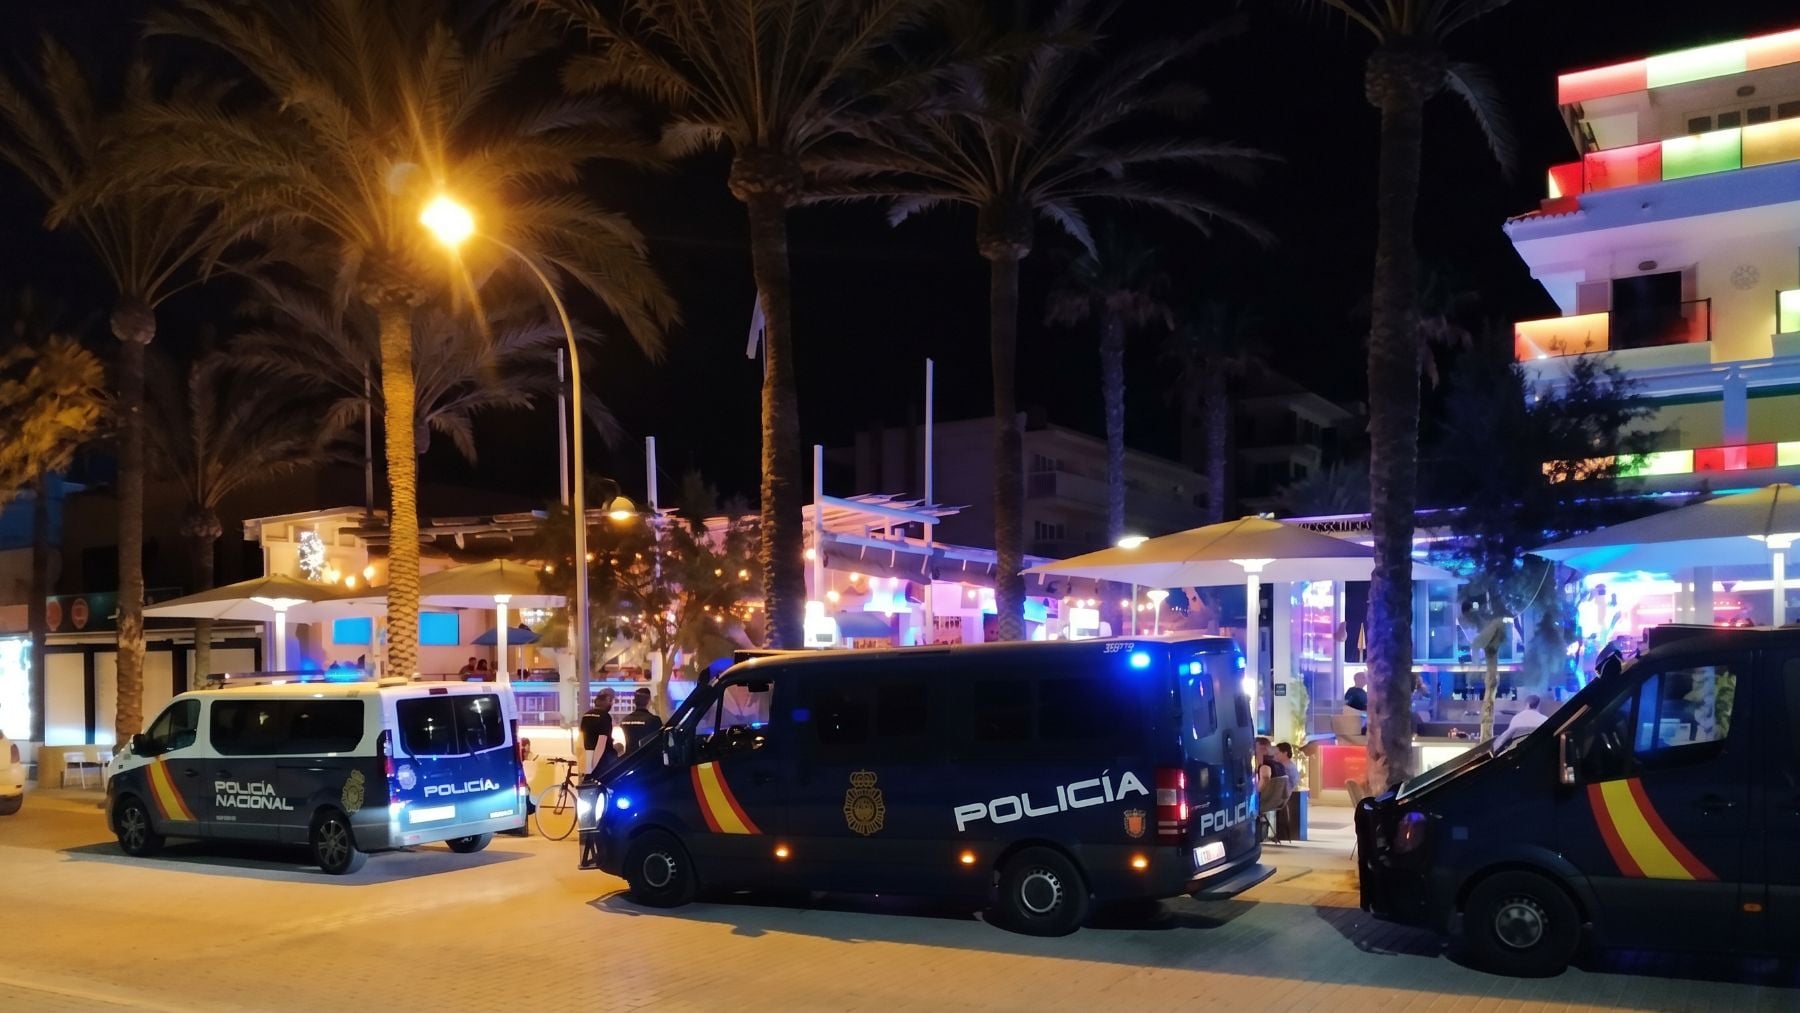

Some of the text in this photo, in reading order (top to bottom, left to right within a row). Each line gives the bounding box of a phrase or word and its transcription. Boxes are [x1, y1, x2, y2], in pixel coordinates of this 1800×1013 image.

[214, 780, 276, 796] POLICÍA
[423, 778, 495, 798] POLICÍA
[215, 794, 295, 811] NACIONAL
[953, 768, 1150, 832] POLICÍA
